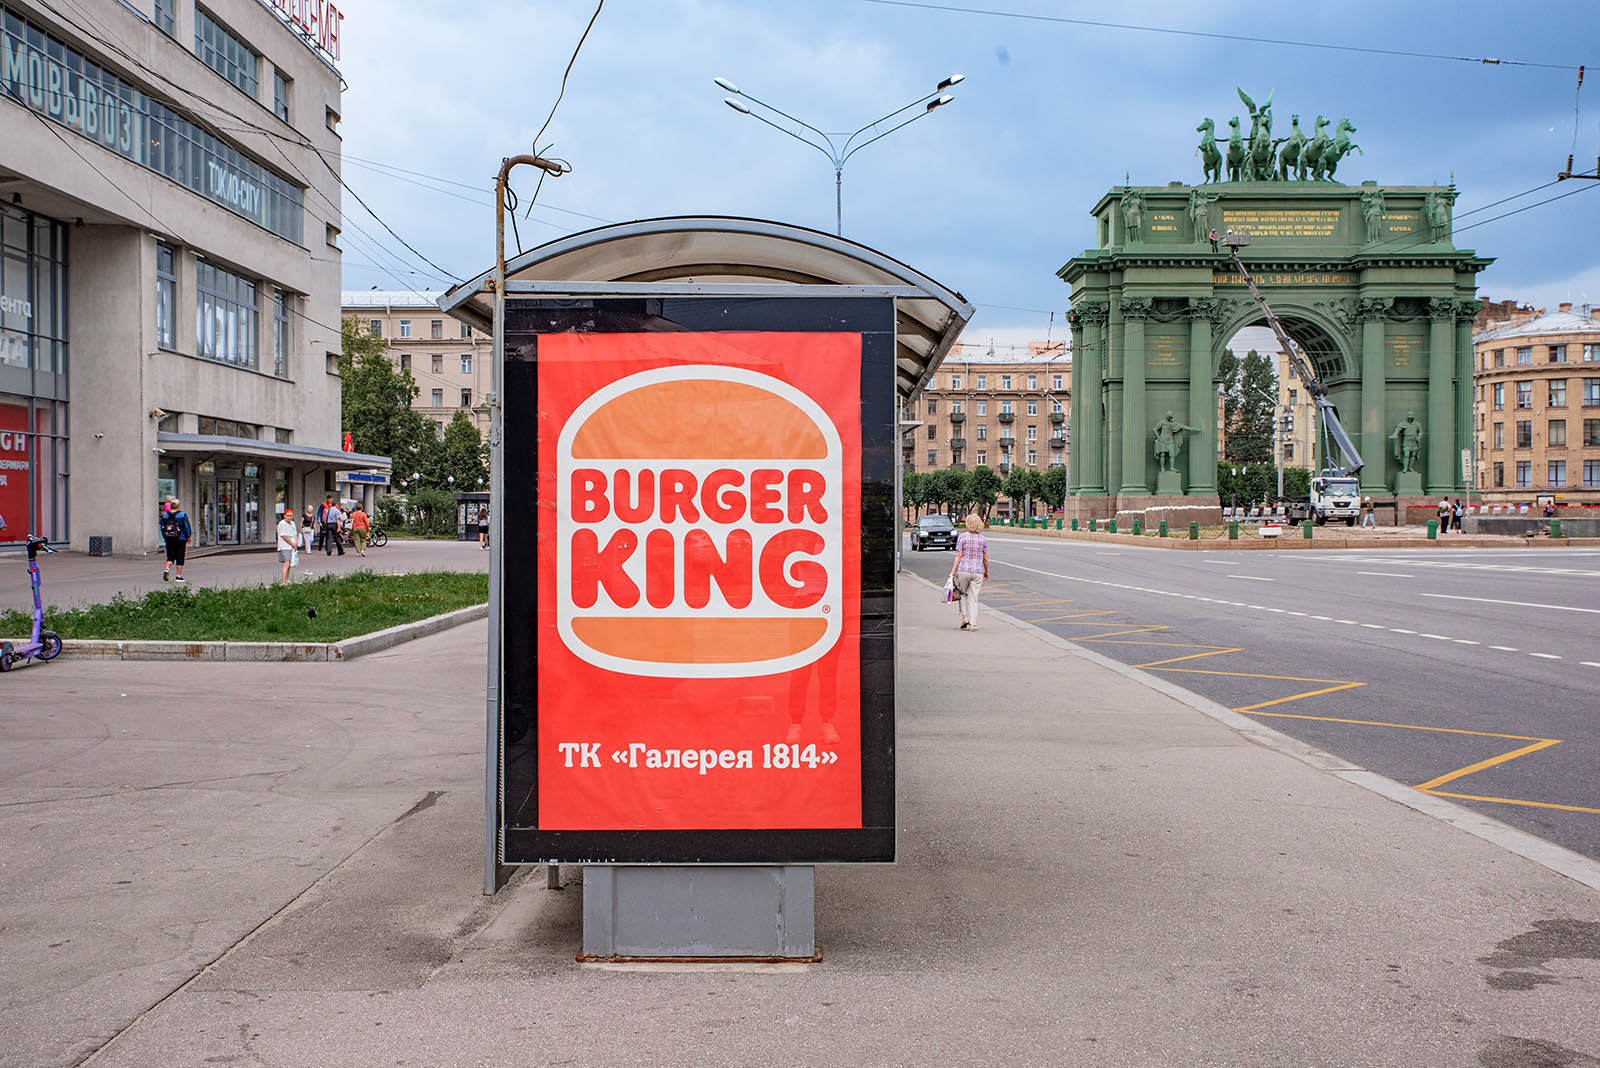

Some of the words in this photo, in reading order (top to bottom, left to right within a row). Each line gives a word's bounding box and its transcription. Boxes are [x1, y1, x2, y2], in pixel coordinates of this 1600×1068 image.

[0, 35, 131, 152] МОВЫВОЗ
[571, 469, 828, 524] BURGER
[571, 528, 828, 609] KING
[558, 742, 601, 768] ТК
[611, 743, 753, 774] «Галерея
[762, 743, 838, 769] 1814»
